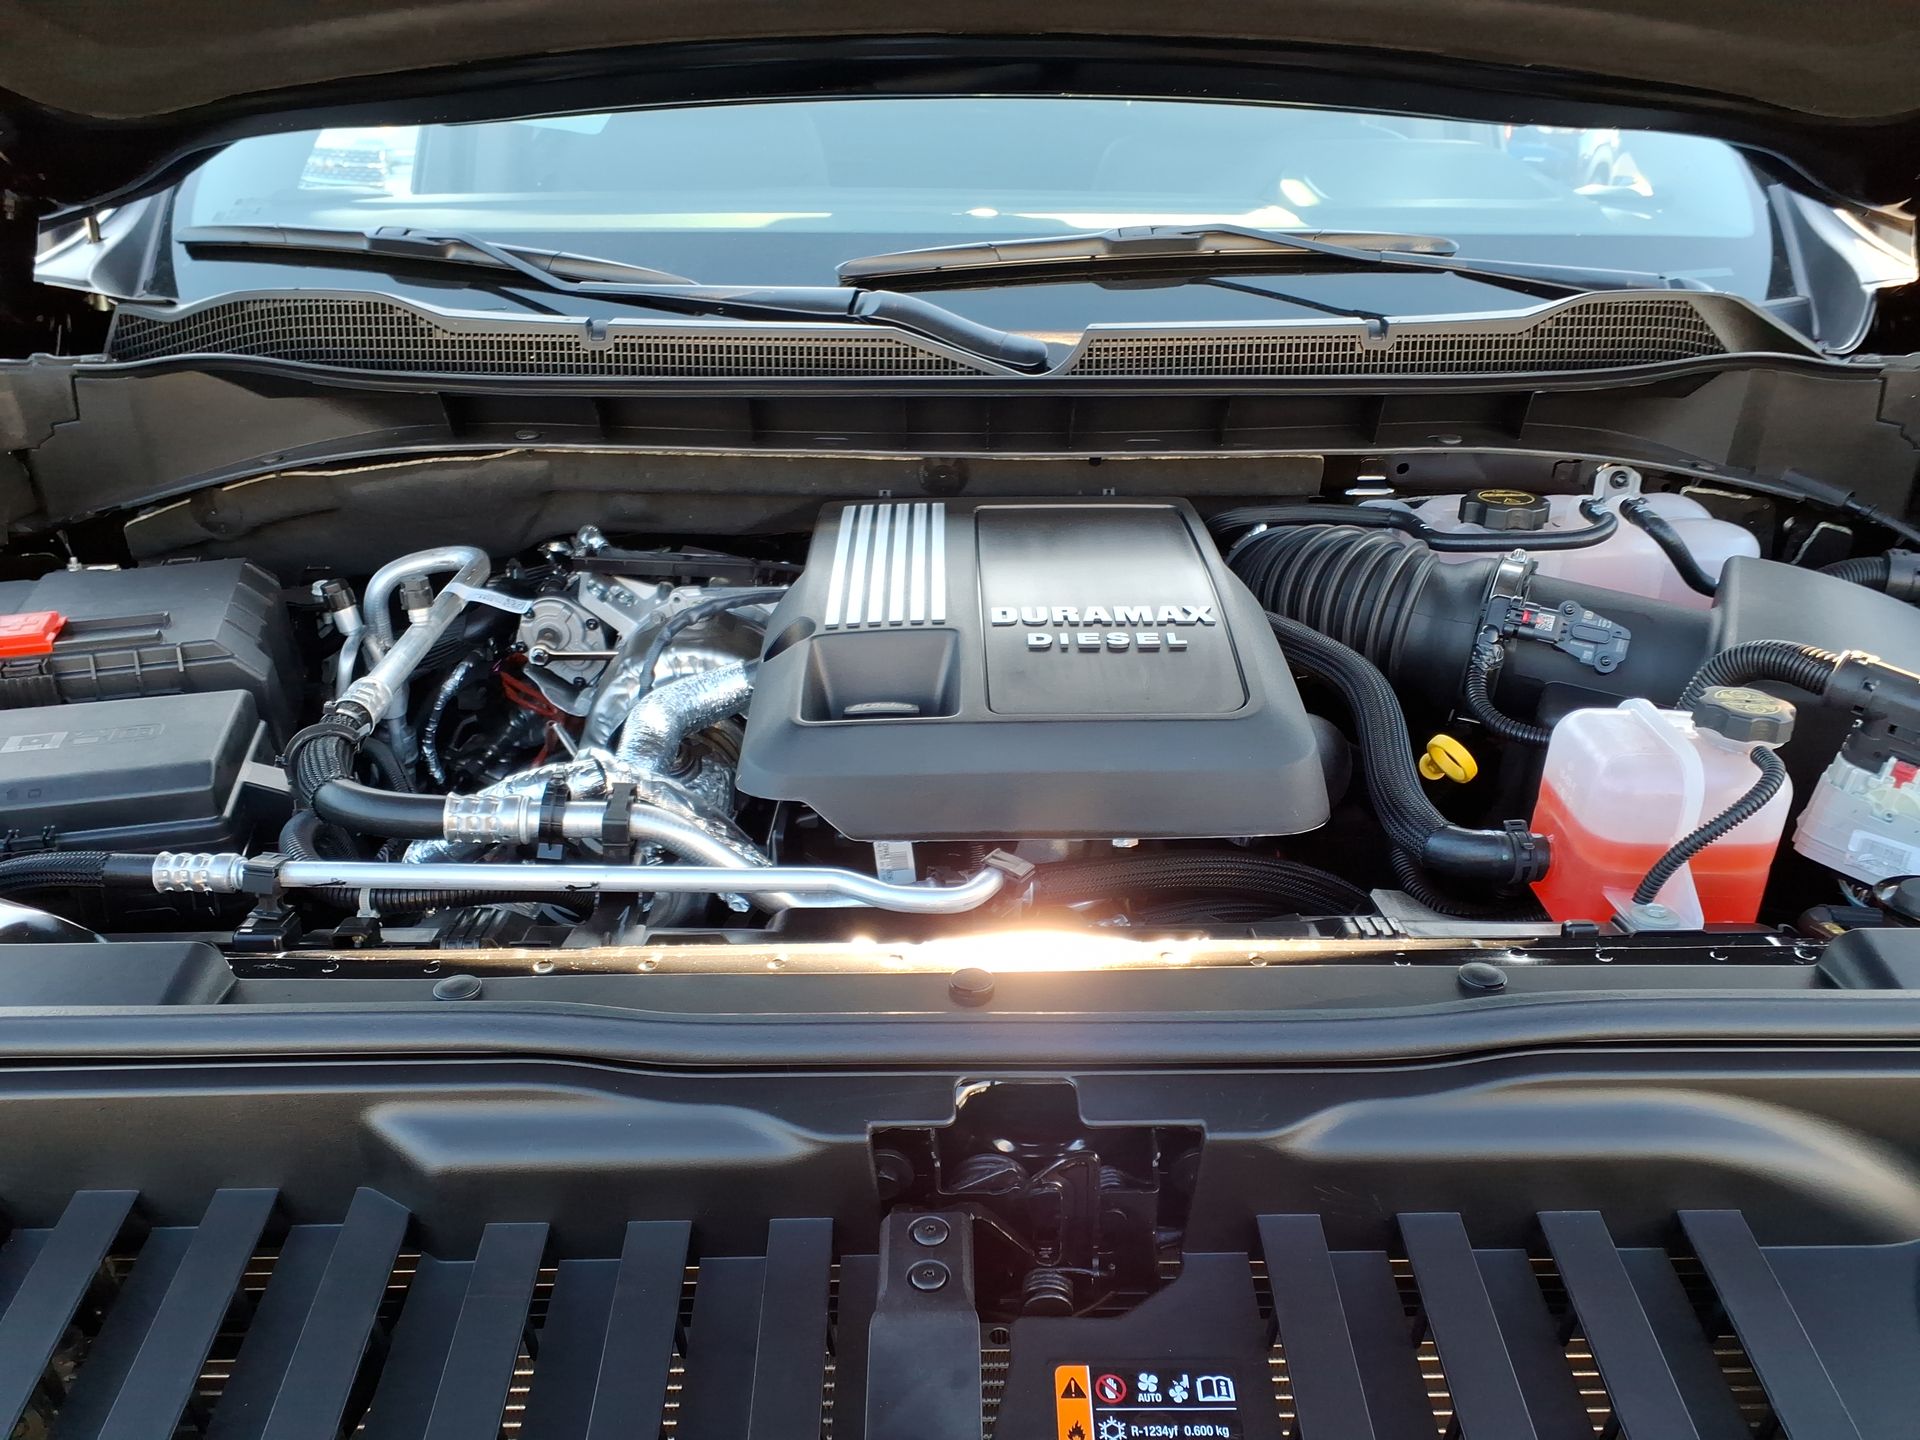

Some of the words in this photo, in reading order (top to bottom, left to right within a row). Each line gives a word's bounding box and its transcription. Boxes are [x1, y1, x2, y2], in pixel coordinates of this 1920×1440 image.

[990, 605, 1217, 626] DURAMAX
[1027, 632, 1188, 650] DIESEL
[1138, 1393, 1162, 1403] AUTO
[1131, 1425, 1178, 1439] R-1234yf
[1184, 1425, 1213, 1436] 0.600
[1215, 1425, 1230, 1438] kg
